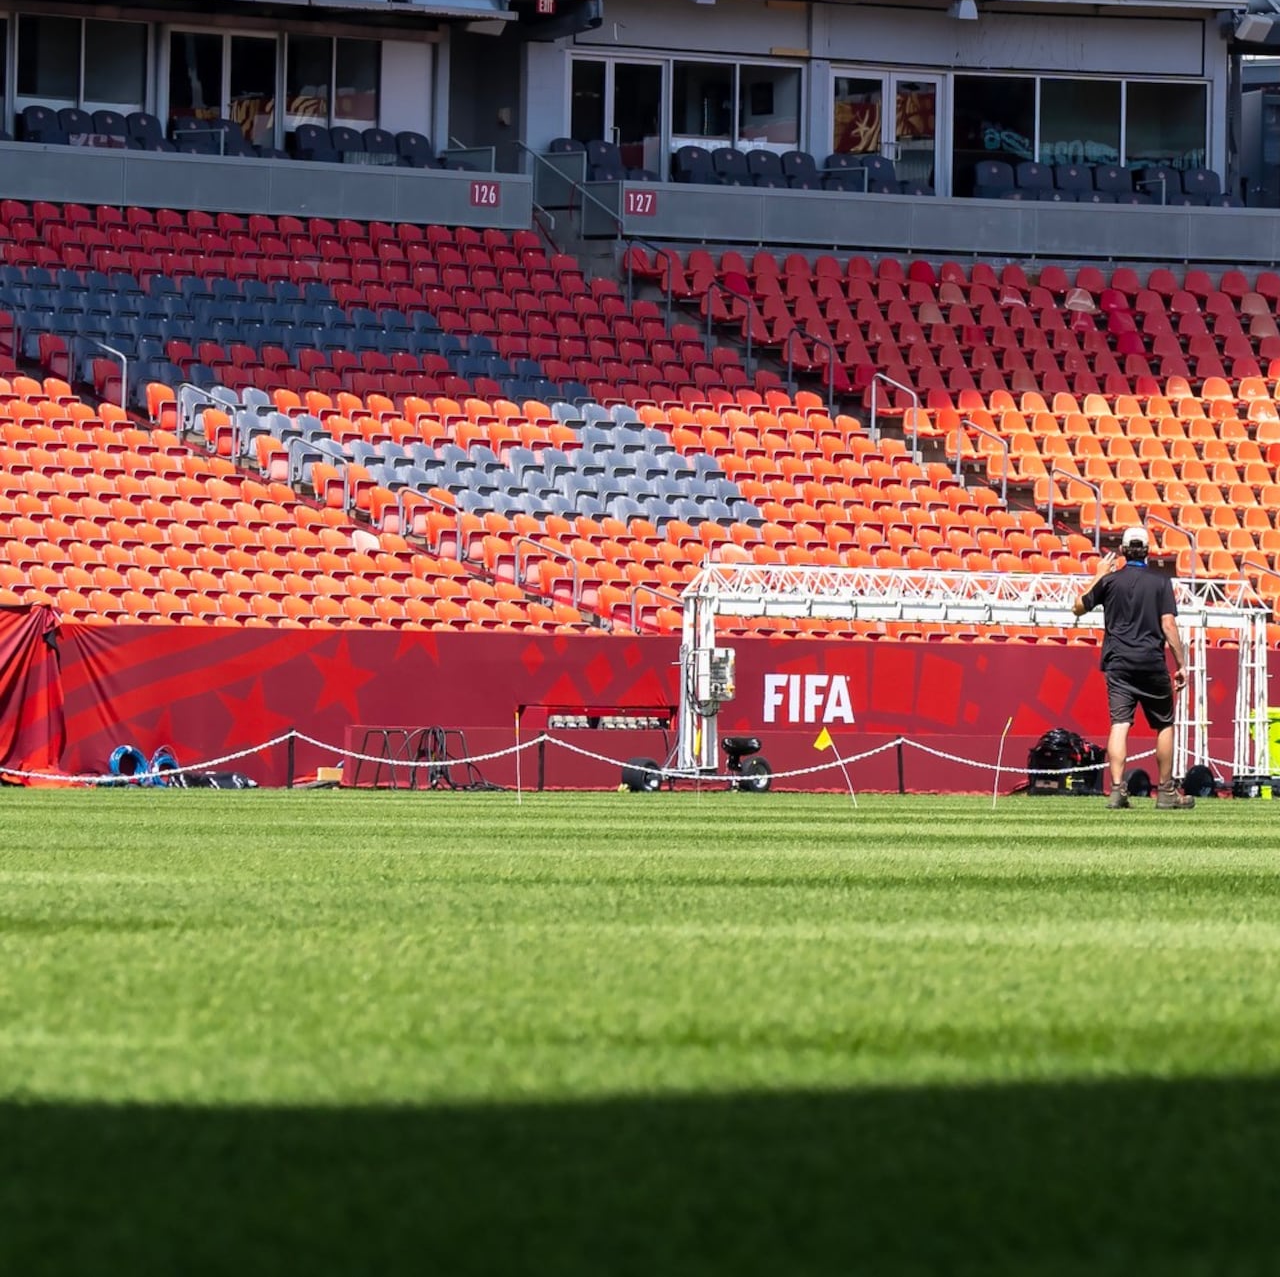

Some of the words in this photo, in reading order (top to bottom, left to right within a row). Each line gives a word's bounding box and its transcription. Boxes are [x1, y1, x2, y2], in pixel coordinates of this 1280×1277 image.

[475, 185, 496, 203] 126
[629, 194, 652, 212] 127
[764, 674, 855, 724] FIFA
